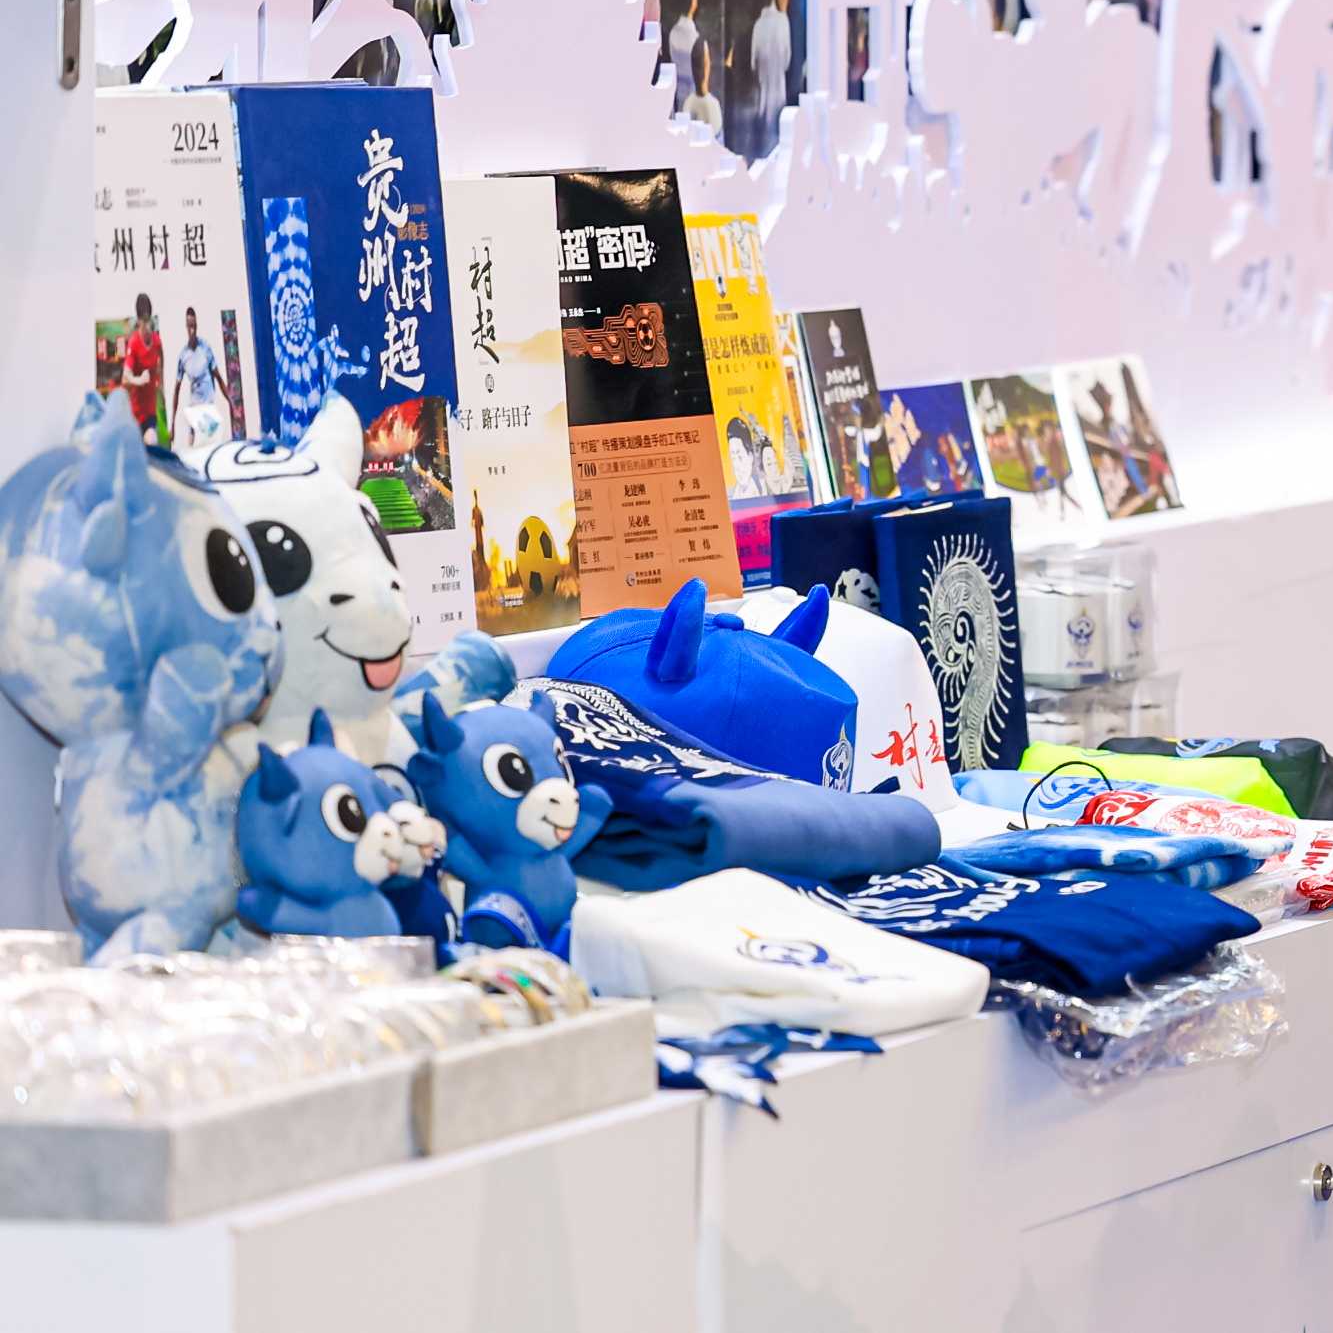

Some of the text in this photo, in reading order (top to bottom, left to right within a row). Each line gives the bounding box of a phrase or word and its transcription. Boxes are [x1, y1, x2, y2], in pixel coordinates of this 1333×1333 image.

[171, 122, 220, 152] 2024
[95, 223, 207, 274] 州村超
